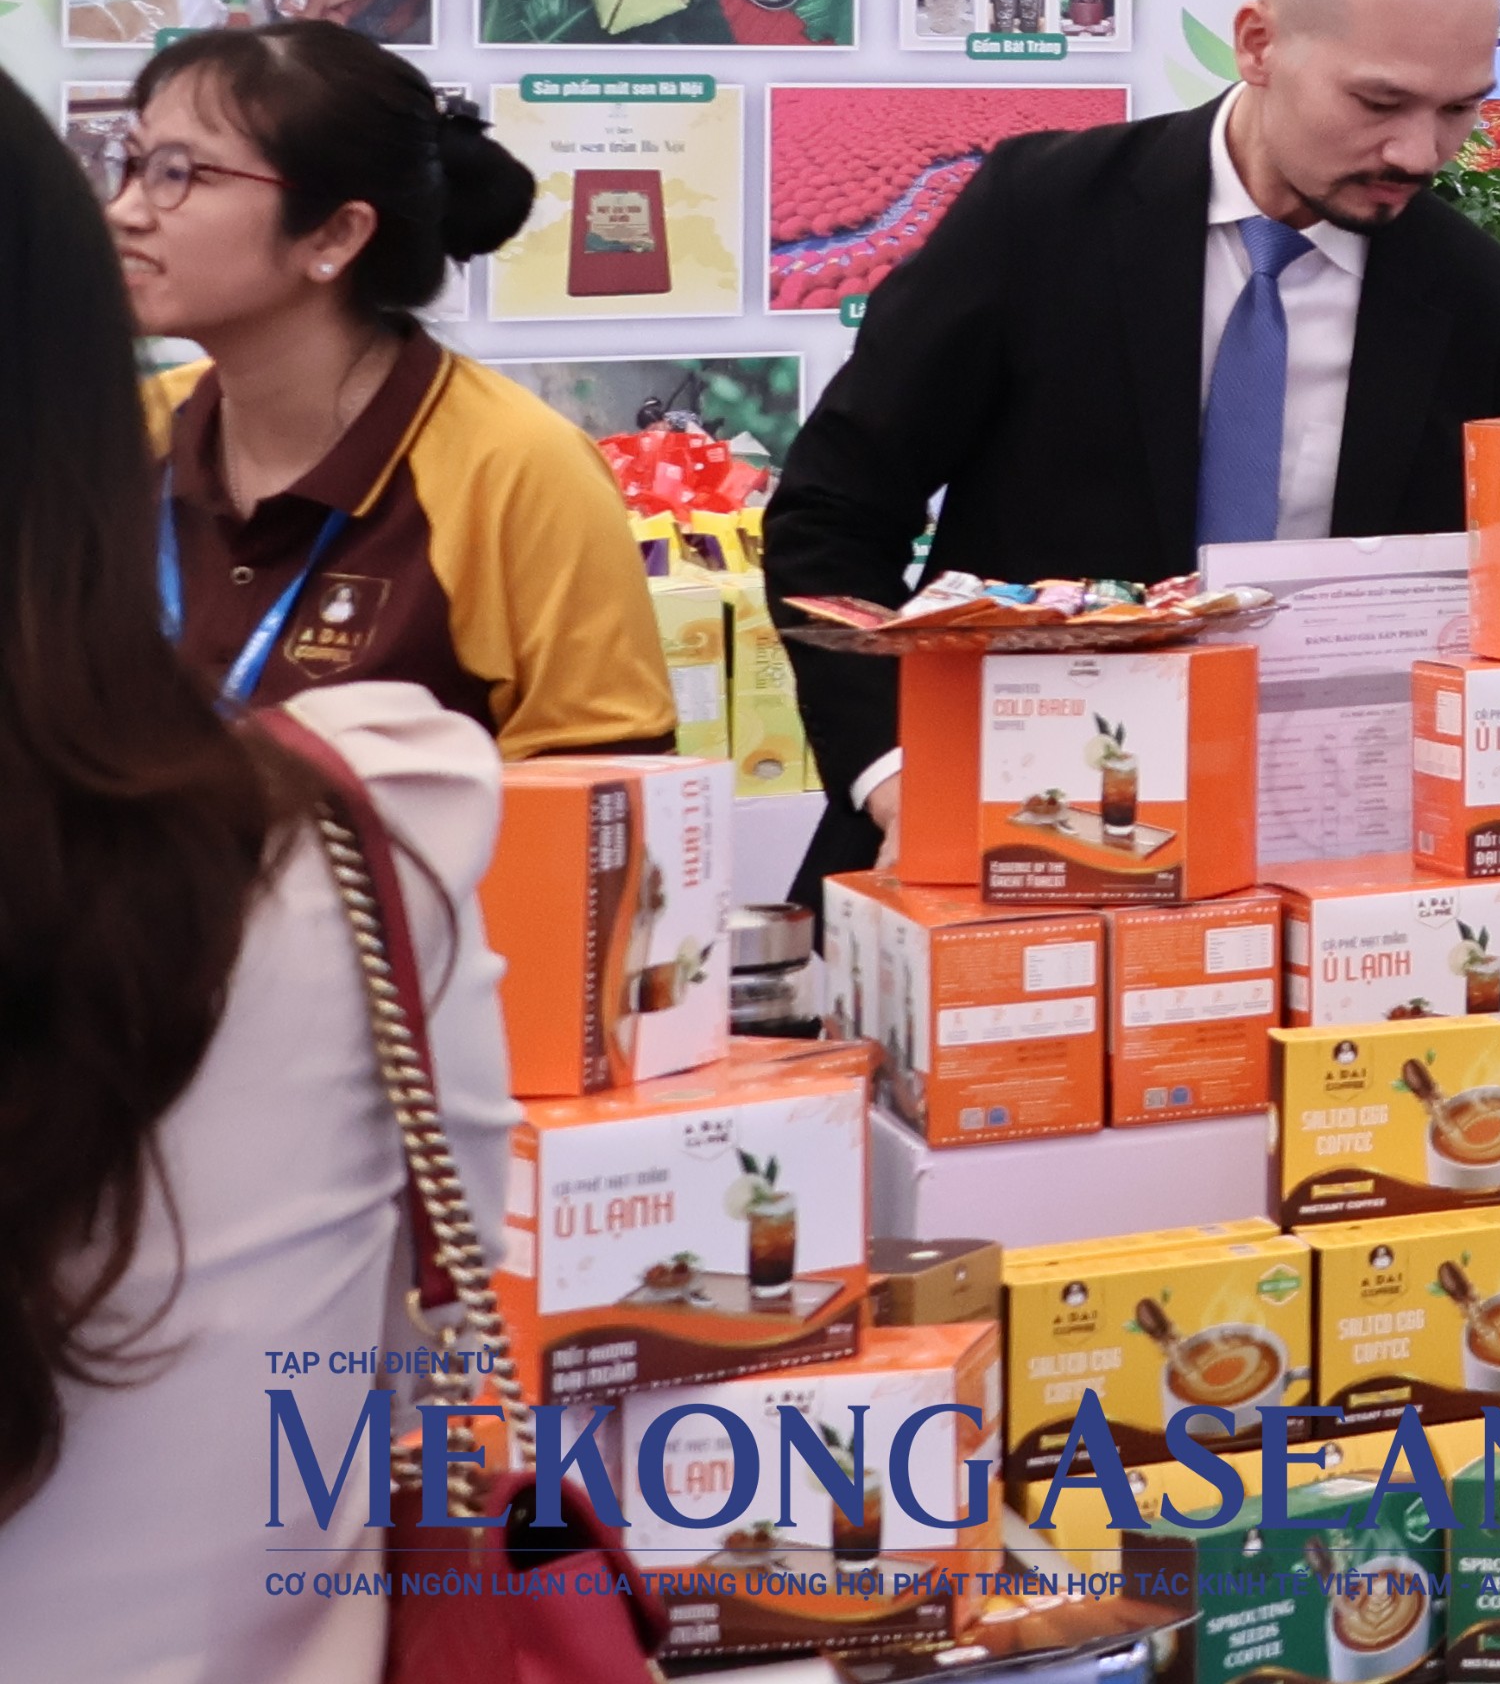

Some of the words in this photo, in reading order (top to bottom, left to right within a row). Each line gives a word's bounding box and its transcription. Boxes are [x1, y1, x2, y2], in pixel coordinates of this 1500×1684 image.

[972, 38, 1001, 54] Gốm
[1004, 40, 1025, 53] Bát
[1027, 40, 1061, 55] Tràng
[533, 79, 560, 96] Sản
[563, 79, 601, 97] phẩm
[632, 82, 657, 96] sen
[659, 81, 677, 96] Hà
[680, 81, 705, 98] Nội
